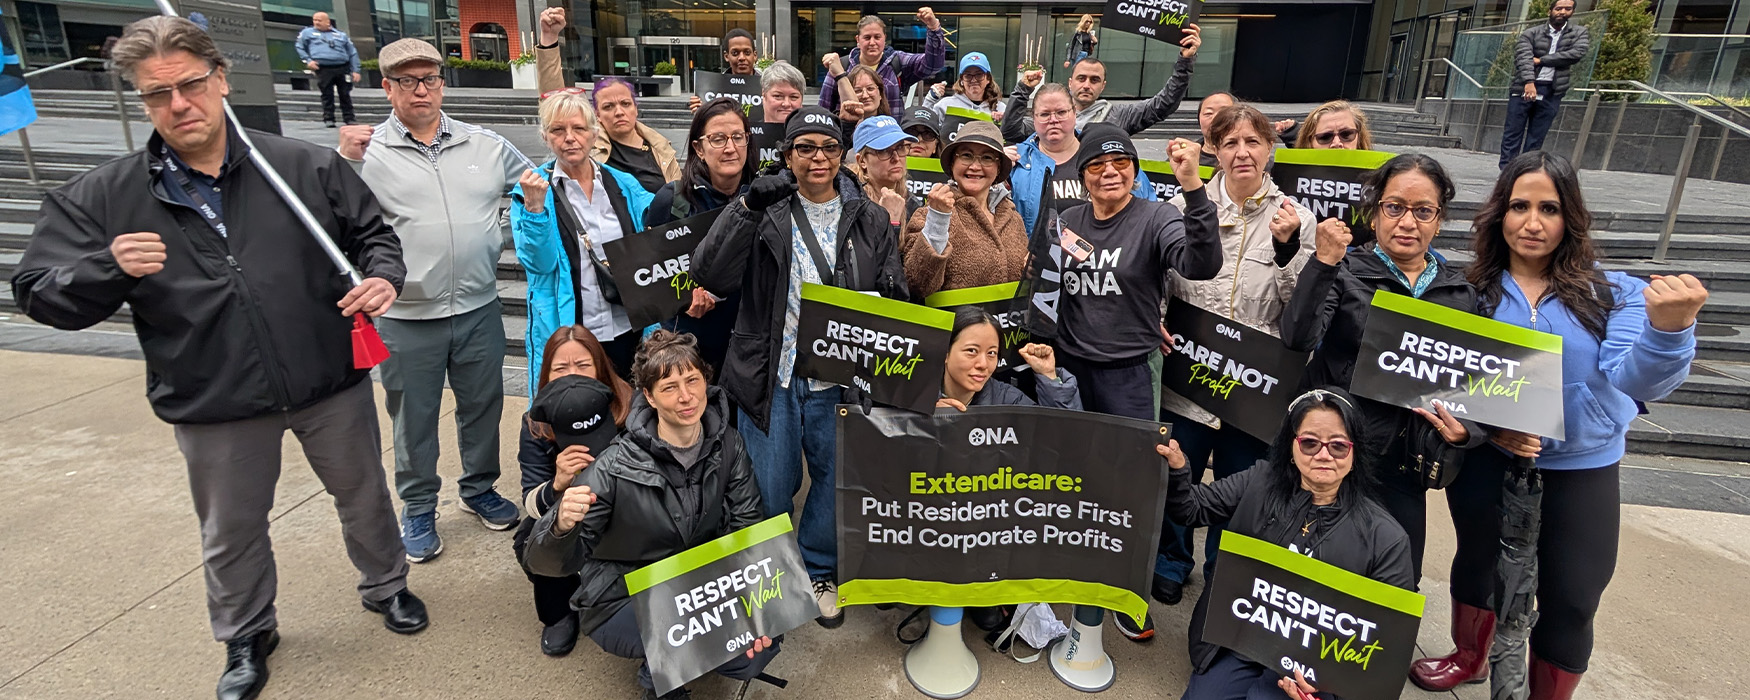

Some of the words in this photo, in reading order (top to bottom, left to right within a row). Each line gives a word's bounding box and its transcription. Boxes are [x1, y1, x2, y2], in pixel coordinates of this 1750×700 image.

[1116, 2, 1160, 20] CAN'T
[1158, 11, 1189, 28] Wait
[1138, 26, 1156, 36] ONA
[729, 77, 746, 85] ONA
[742, 94, 764, 106] NO
[750, 127, 764, 135] NA
[804, 114, 834, 127] ONA
[1296, 177, 1362, 201] RESPE
[200, 203, 217, 219] ONA
[665, 226, 691, 240] ONA
[634, 254, 691, 287] CARE
[1077, 246, 1122, 270] AM
[1063, 271, 1123, 296] ONA
[826, 320, 919, 357] RESPECT
[1215, 323, 1242, 341] ONA
[812, 338, 873, 368] CAN'T
[874, 351, 924, 381] Wait
[1171, 333, 1223, 371] CARE
[1222, 358, 1279, 395] NOT
[1399, 331, 1521, 379] RESPECT
[852, 375, 872, 394] ONA
[1190, 363, 1243, 400] Profit
[1378, 351, 1464, 388] CAN'T
[1467, 371, 1532, 402] Wait
[572, 413, 602, 430] ONA
[968, 427, 1019, 446] ONA
[910, 466, 1083, 494] Extendicare:
[862, 497, 901, 519] Put
[908, 499, 1009, 522] Resident
[1014, 497, 1071, 519] Care
[1078, 500, 1132, 529] First
[868, 523, 913, 544] End
[918, 524, 1037, 553] Corporate
[1043, 524, 1123, 553] Profits
[674, 557, 772, 617] RESPECT
[667, 597, 738, 647] CAN'T
[740, 568, 785, 618] Wait
[1252, 577, 1377, 643] RESPECT
[725, 631, 755, 653] ONA
[1231, 598, 1318, 649] CAN'T
[1320, 633, 1384, 671] Wait
[1280, 656, 1317, 682] ONA
